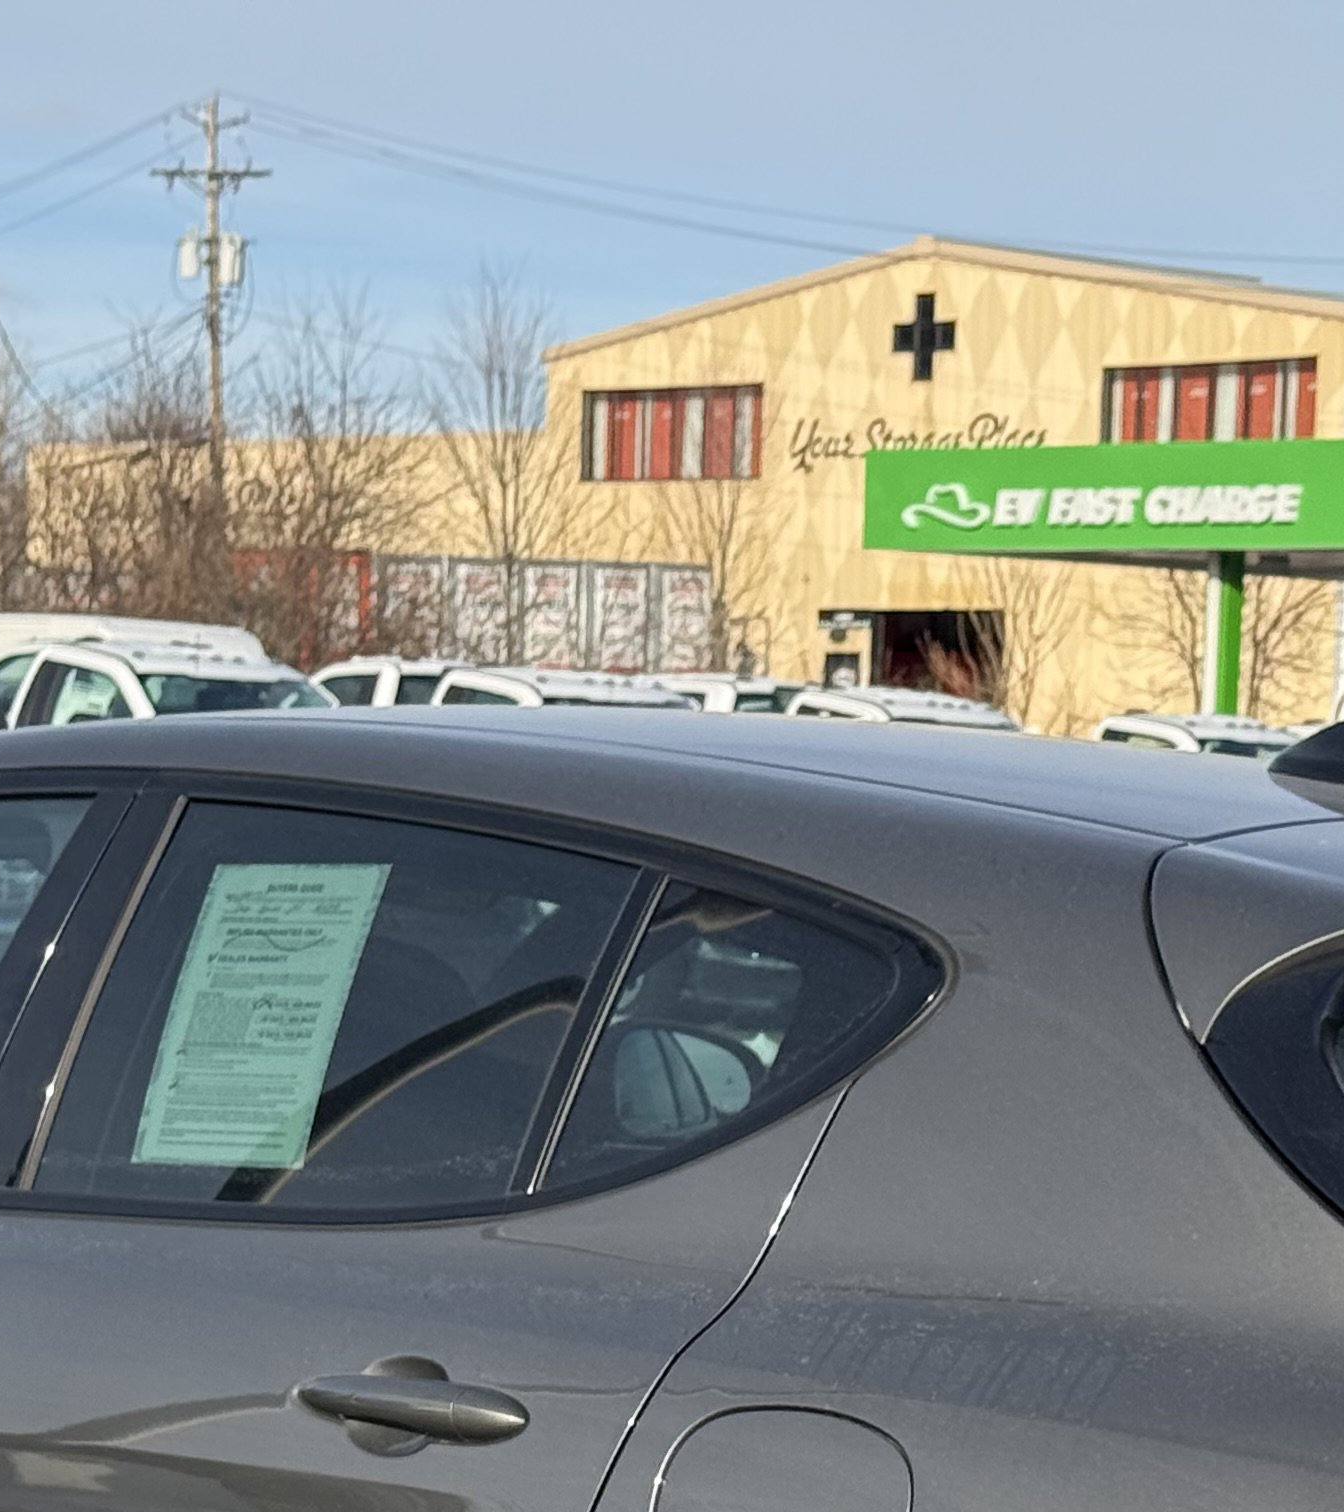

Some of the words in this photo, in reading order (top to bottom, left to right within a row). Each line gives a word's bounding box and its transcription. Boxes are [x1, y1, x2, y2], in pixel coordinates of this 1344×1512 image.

[788, 417, 862, 474] Your
[992, 487, 1046, 526] EV
[1046, 486, 1143, 526] FAST
[1144, 484, 1303, 525] CHARGE
